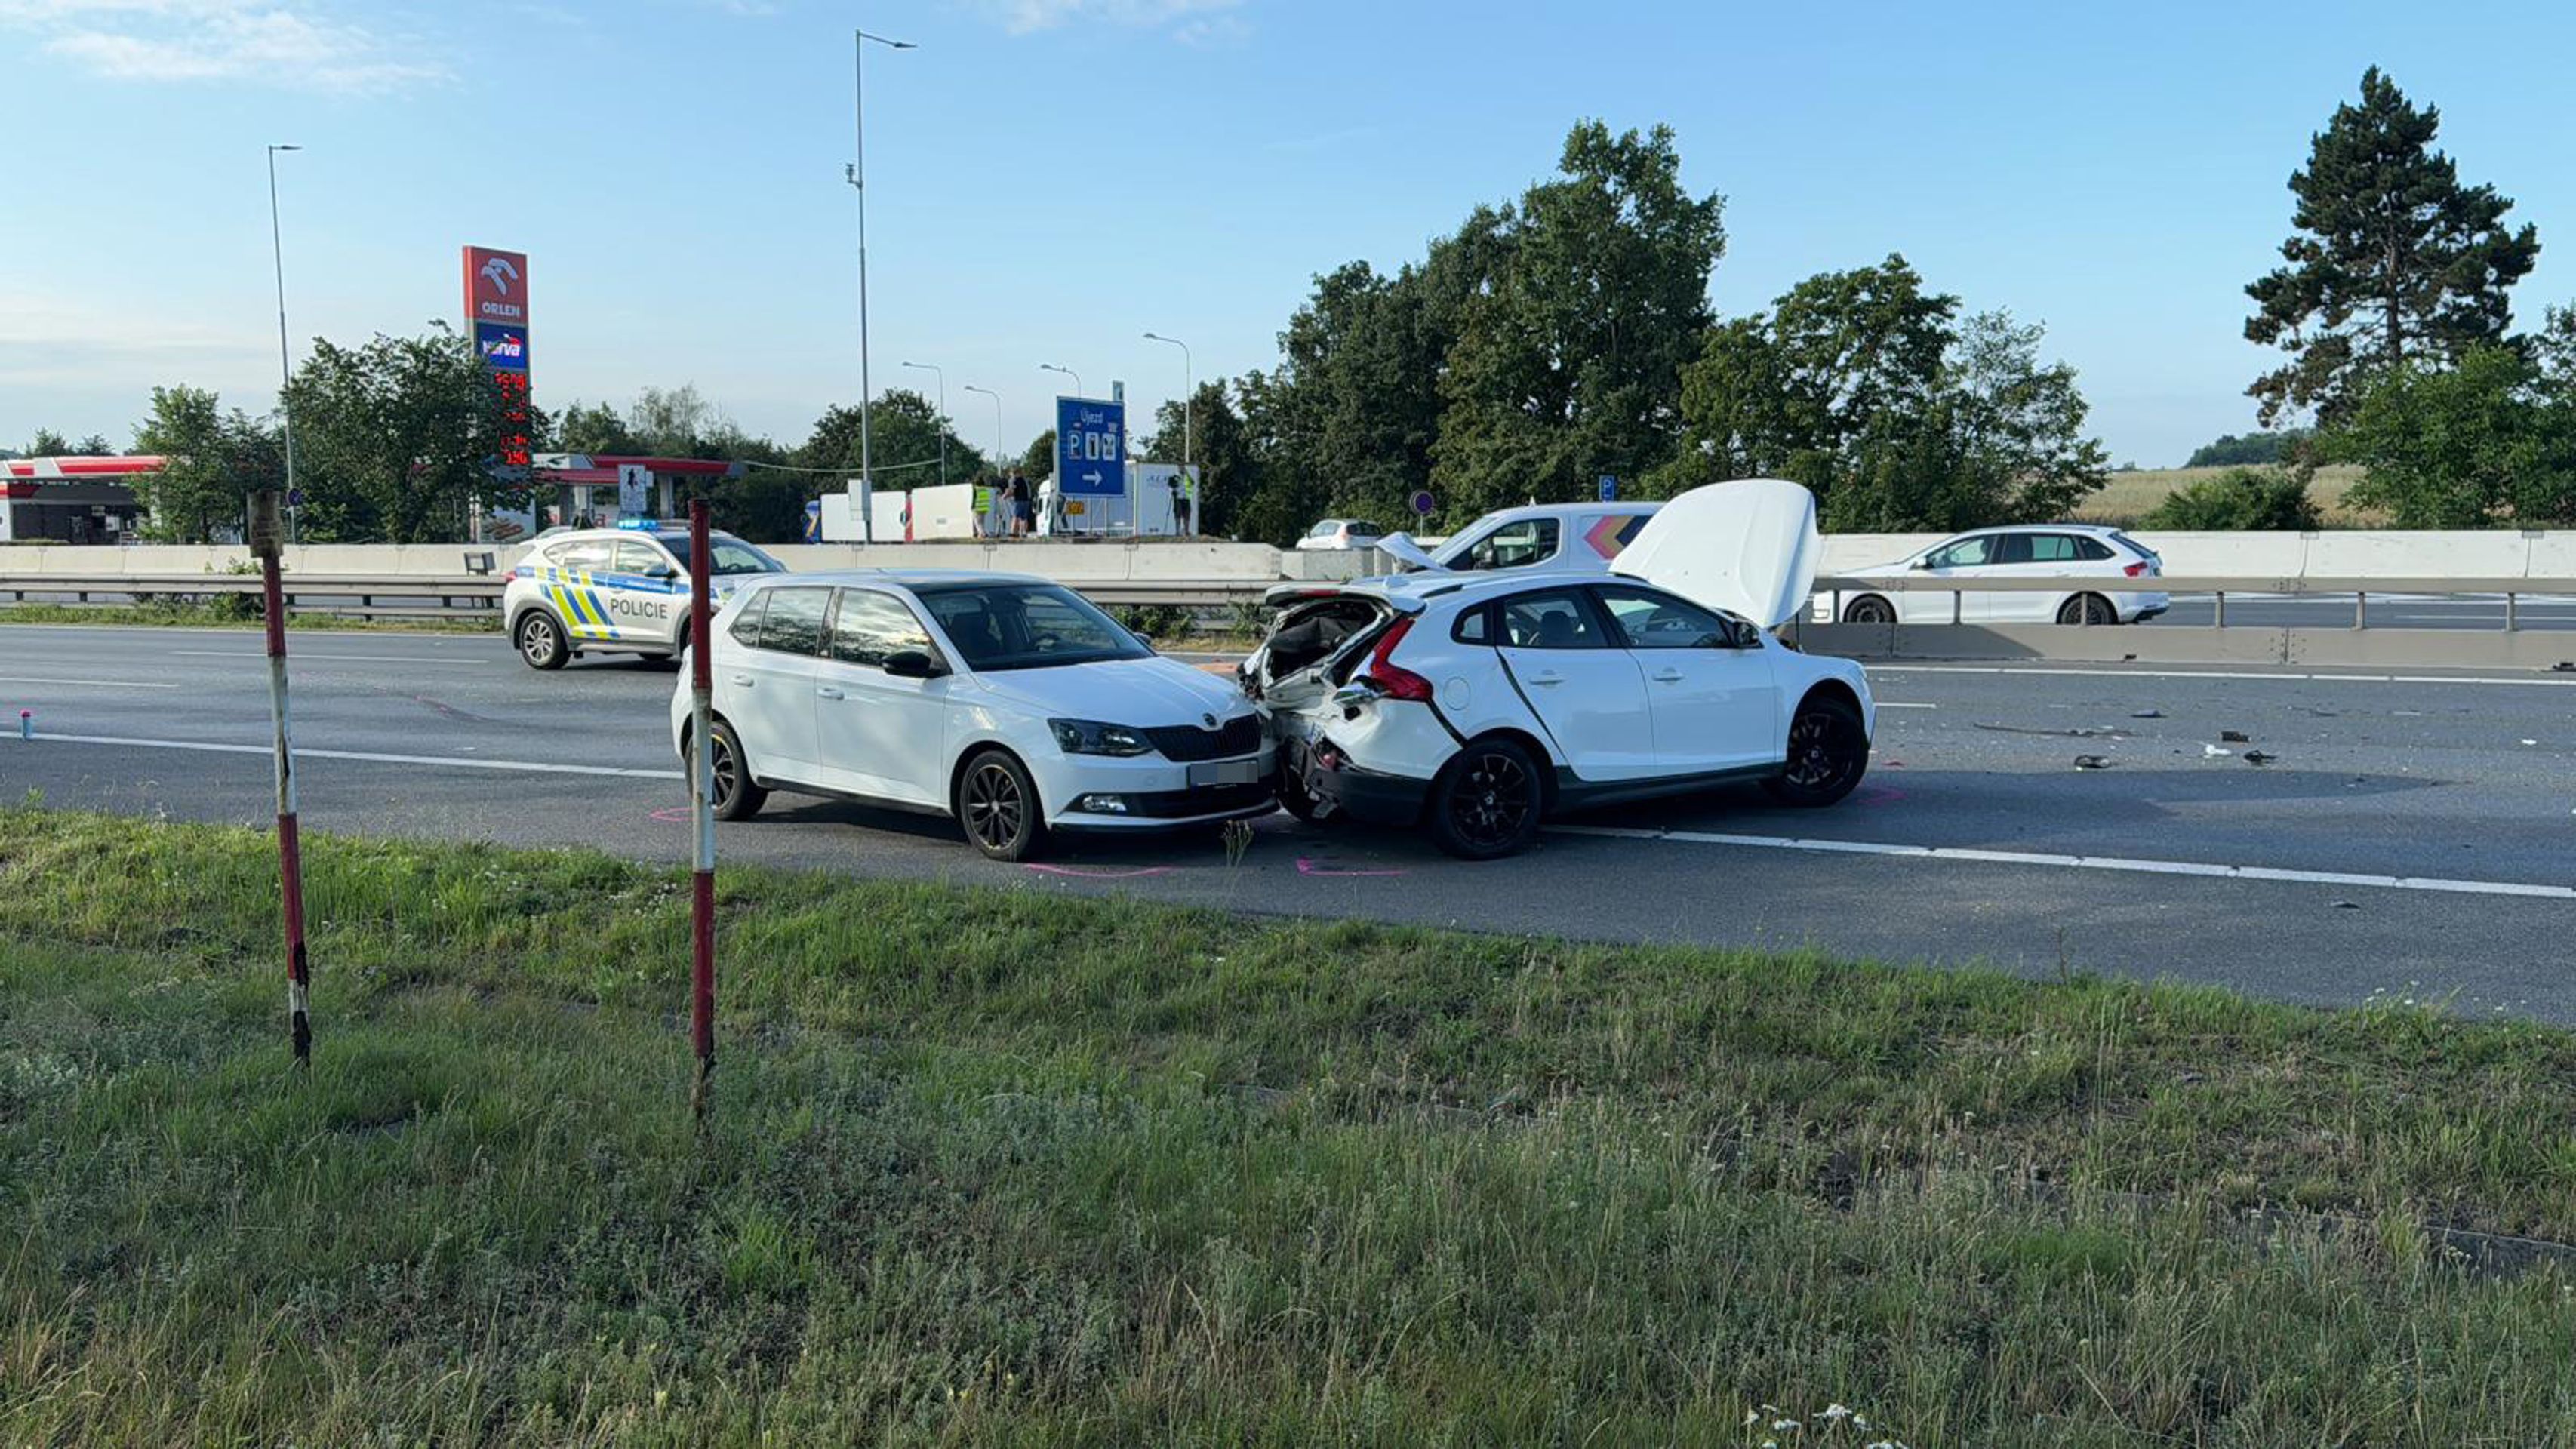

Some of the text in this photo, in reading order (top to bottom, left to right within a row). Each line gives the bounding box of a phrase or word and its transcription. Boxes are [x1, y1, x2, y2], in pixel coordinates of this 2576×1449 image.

[482, 301, 520, 318] ORLEN
[1070, 433, 1080, 454] P
[610, 598, 668, 620] POLICIE
